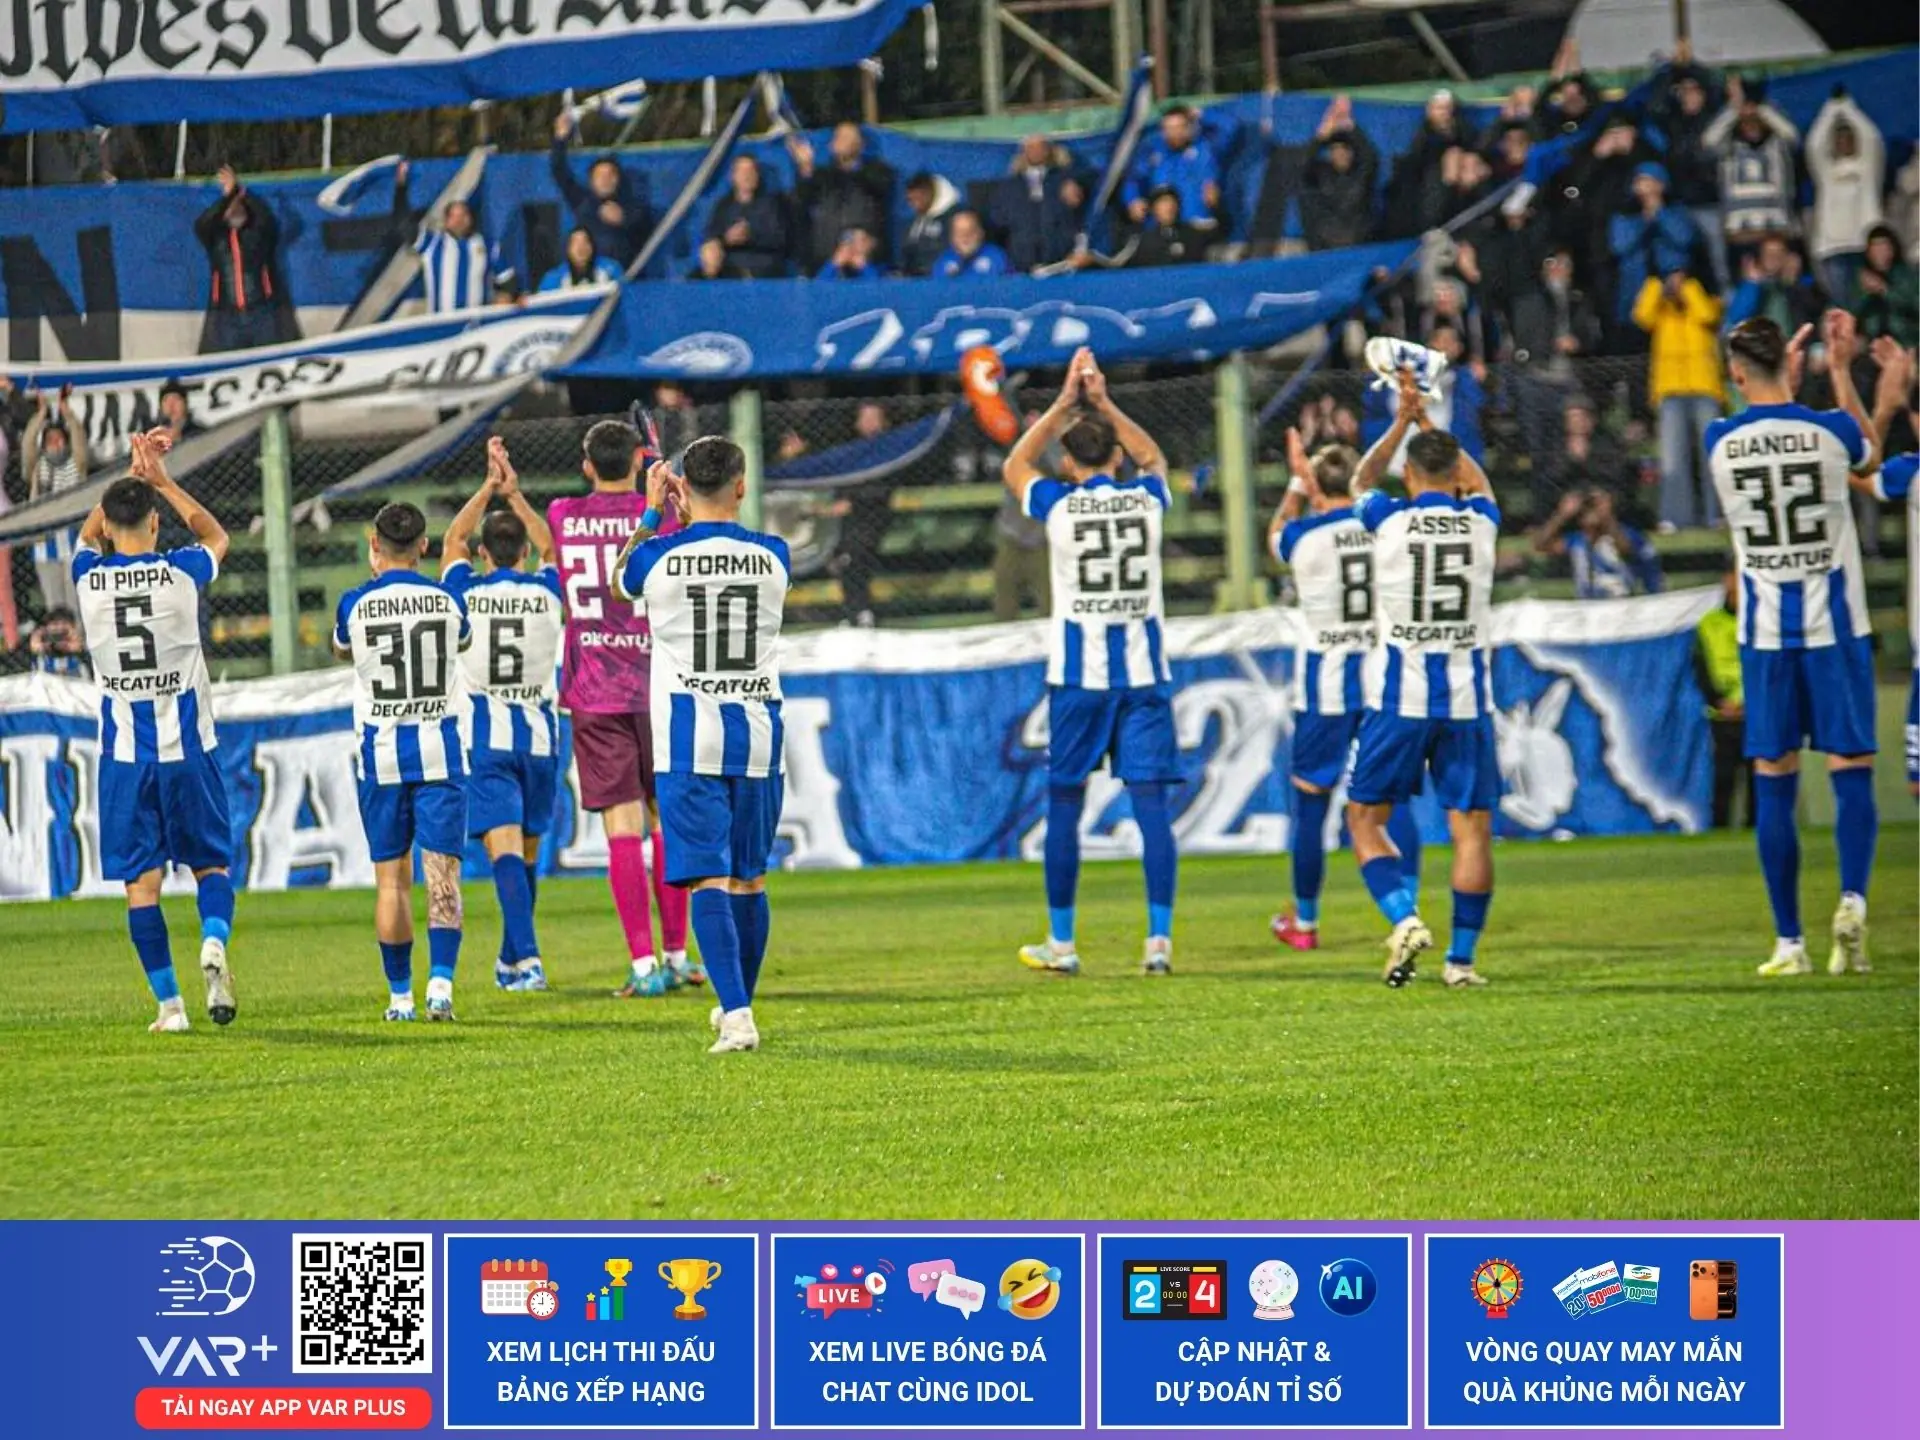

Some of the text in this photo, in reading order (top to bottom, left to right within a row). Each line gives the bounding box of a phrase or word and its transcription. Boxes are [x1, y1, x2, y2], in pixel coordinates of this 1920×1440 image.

[1408, 517, 1471, 535] ASSIS
[1733, 462, 1827, 546] 32
[89, 567, 174, 591] DI PIPPA
[666, 555, 773, 576] OTORMIN
[1074, 518, 1149, 592] 22
[1341, 552, 1374, 622] 8
[1409, 543, 1472, 622] 15
[114, 595, 157, 672] 5
[358, 595, 452, 620] HERNANDEZ
[468, 595, 549, 615] BONIFAZI
[687, 585, 758, 672] 10
[1391, 624, 1477, 642] DECATUR
[365, 620, 448, 700] 30
[489, 618, 524, 685] 6
